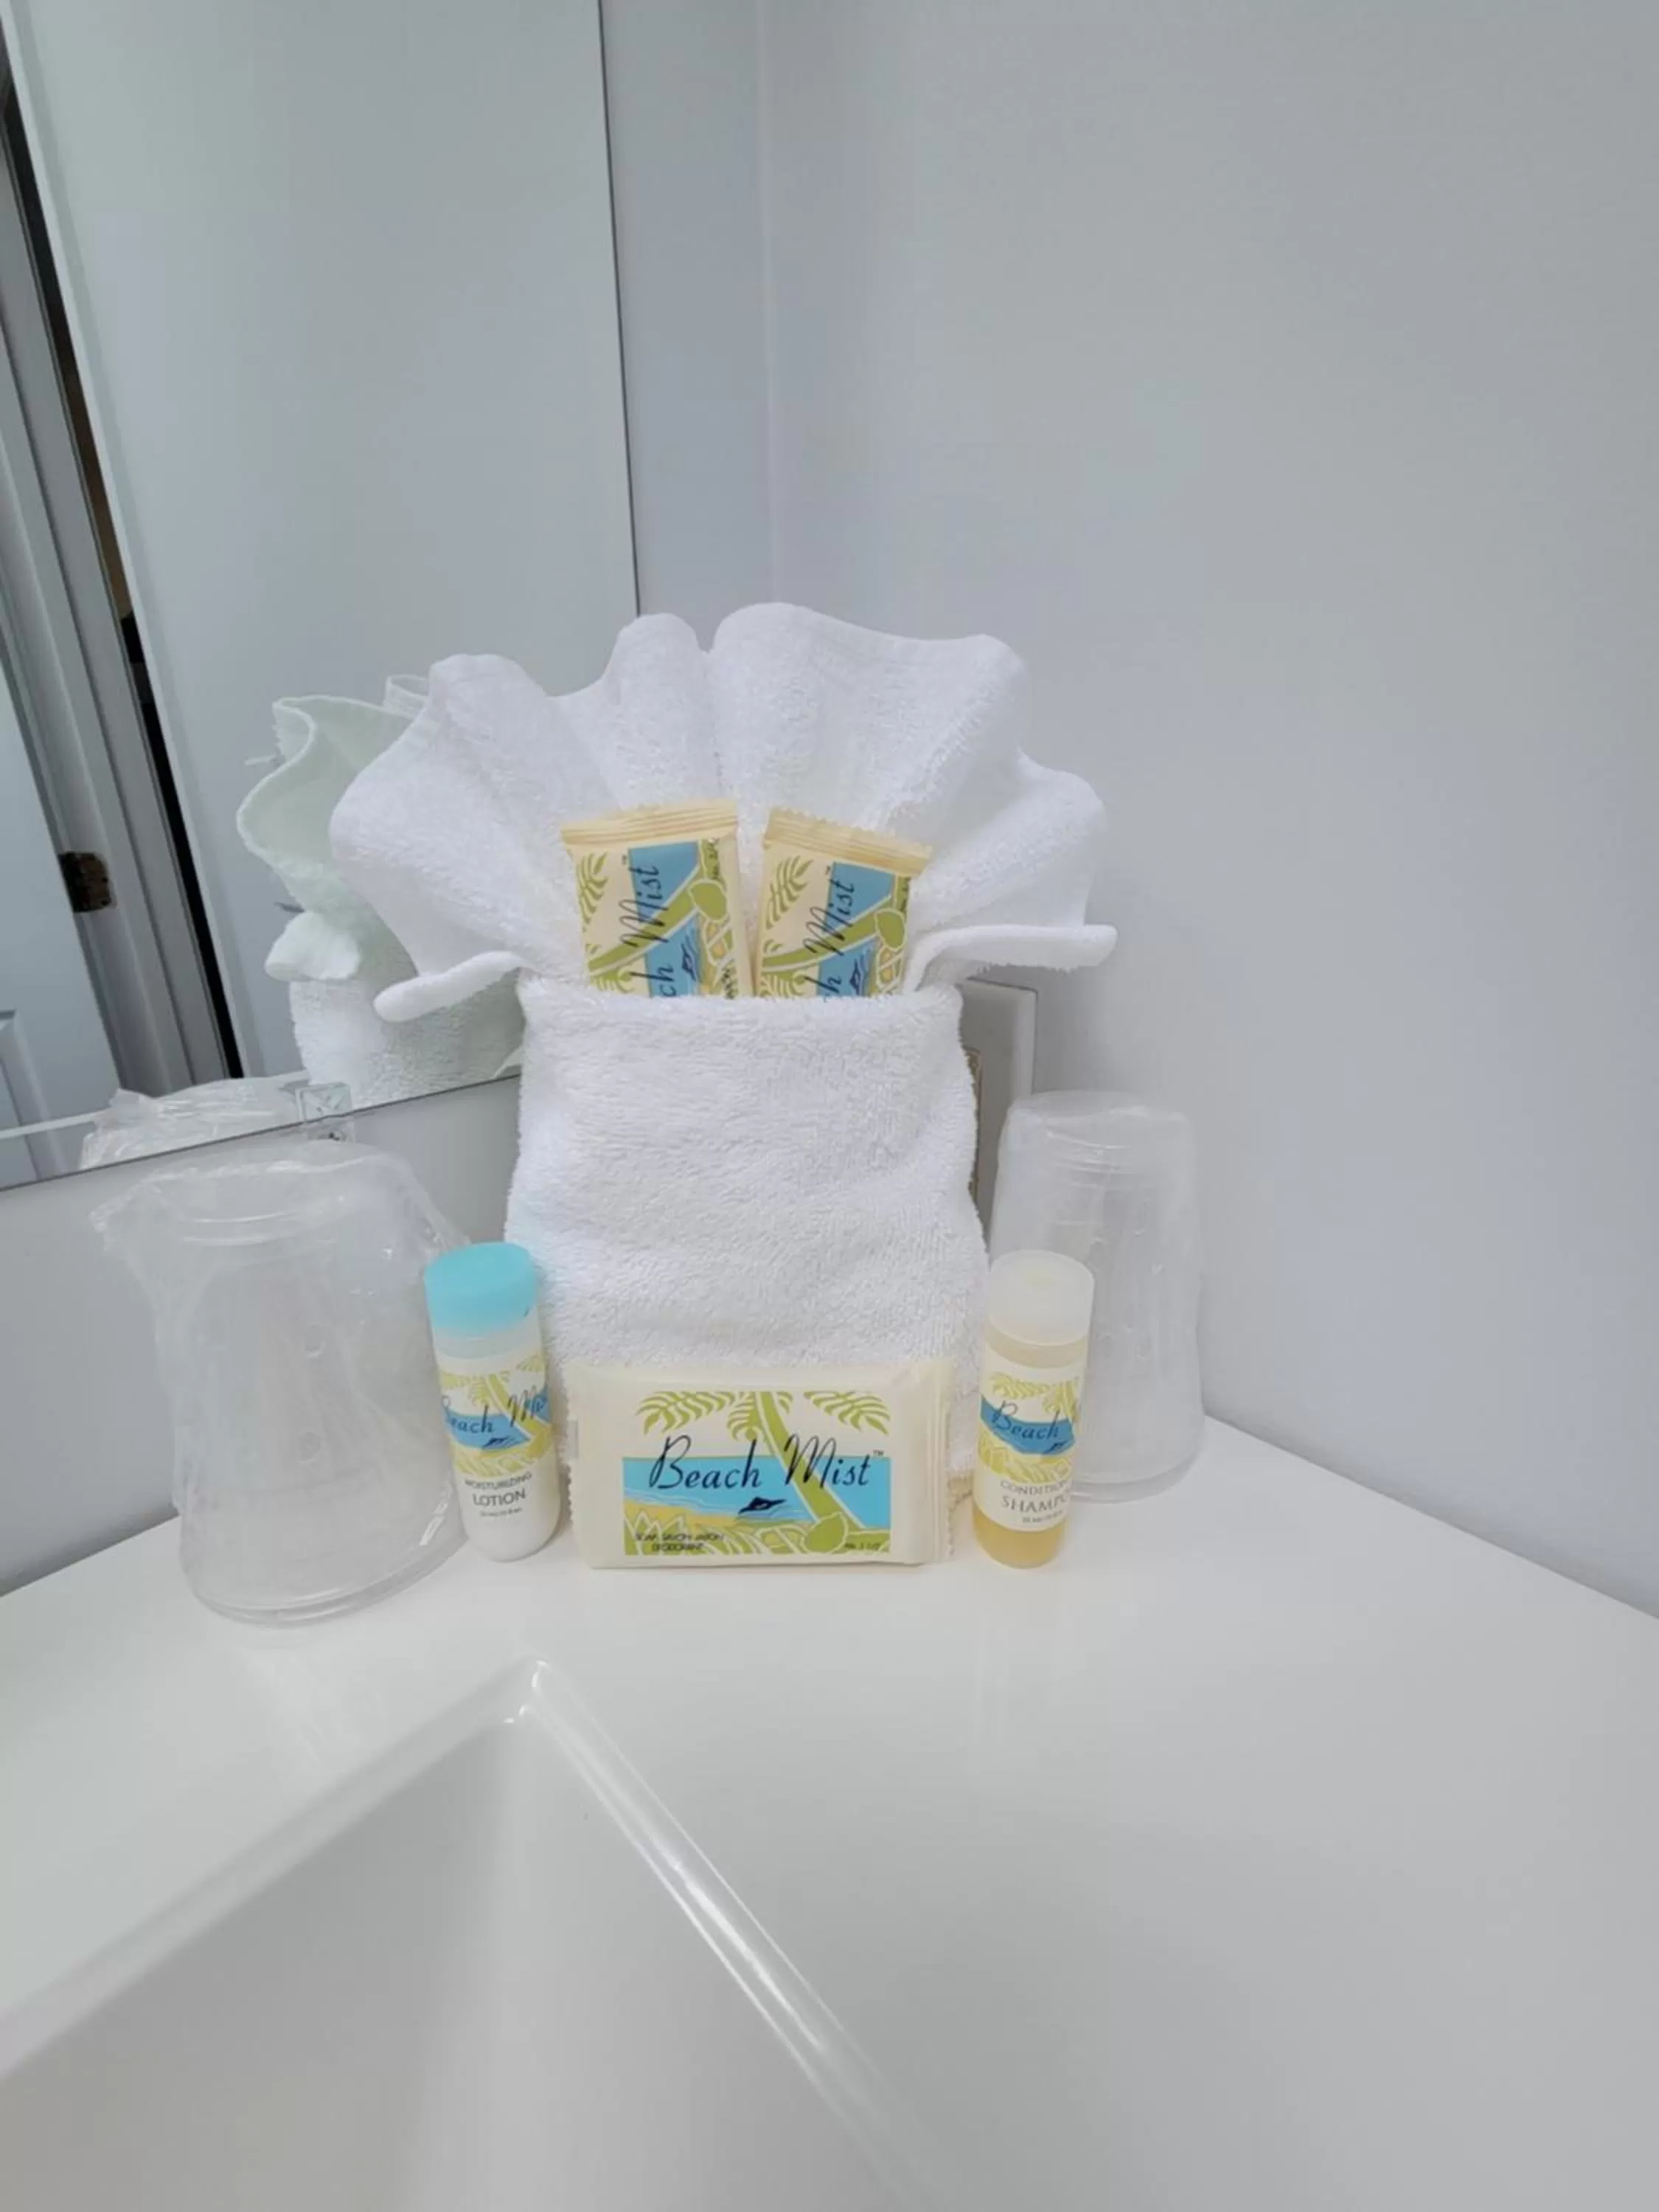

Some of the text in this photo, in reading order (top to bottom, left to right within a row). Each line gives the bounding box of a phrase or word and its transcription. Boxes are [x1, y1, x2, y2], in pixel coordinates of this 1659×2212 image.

[619, 863, 669, 947] Mist
[802, 876, 855, 956] Mist
[991, 1399, 1060, 1440] Beach
[648, 1433, 762, 1489] Beach
[784, 1433, 871, 1489] Mist
[472, 1487, 526, 1506] LOTION
